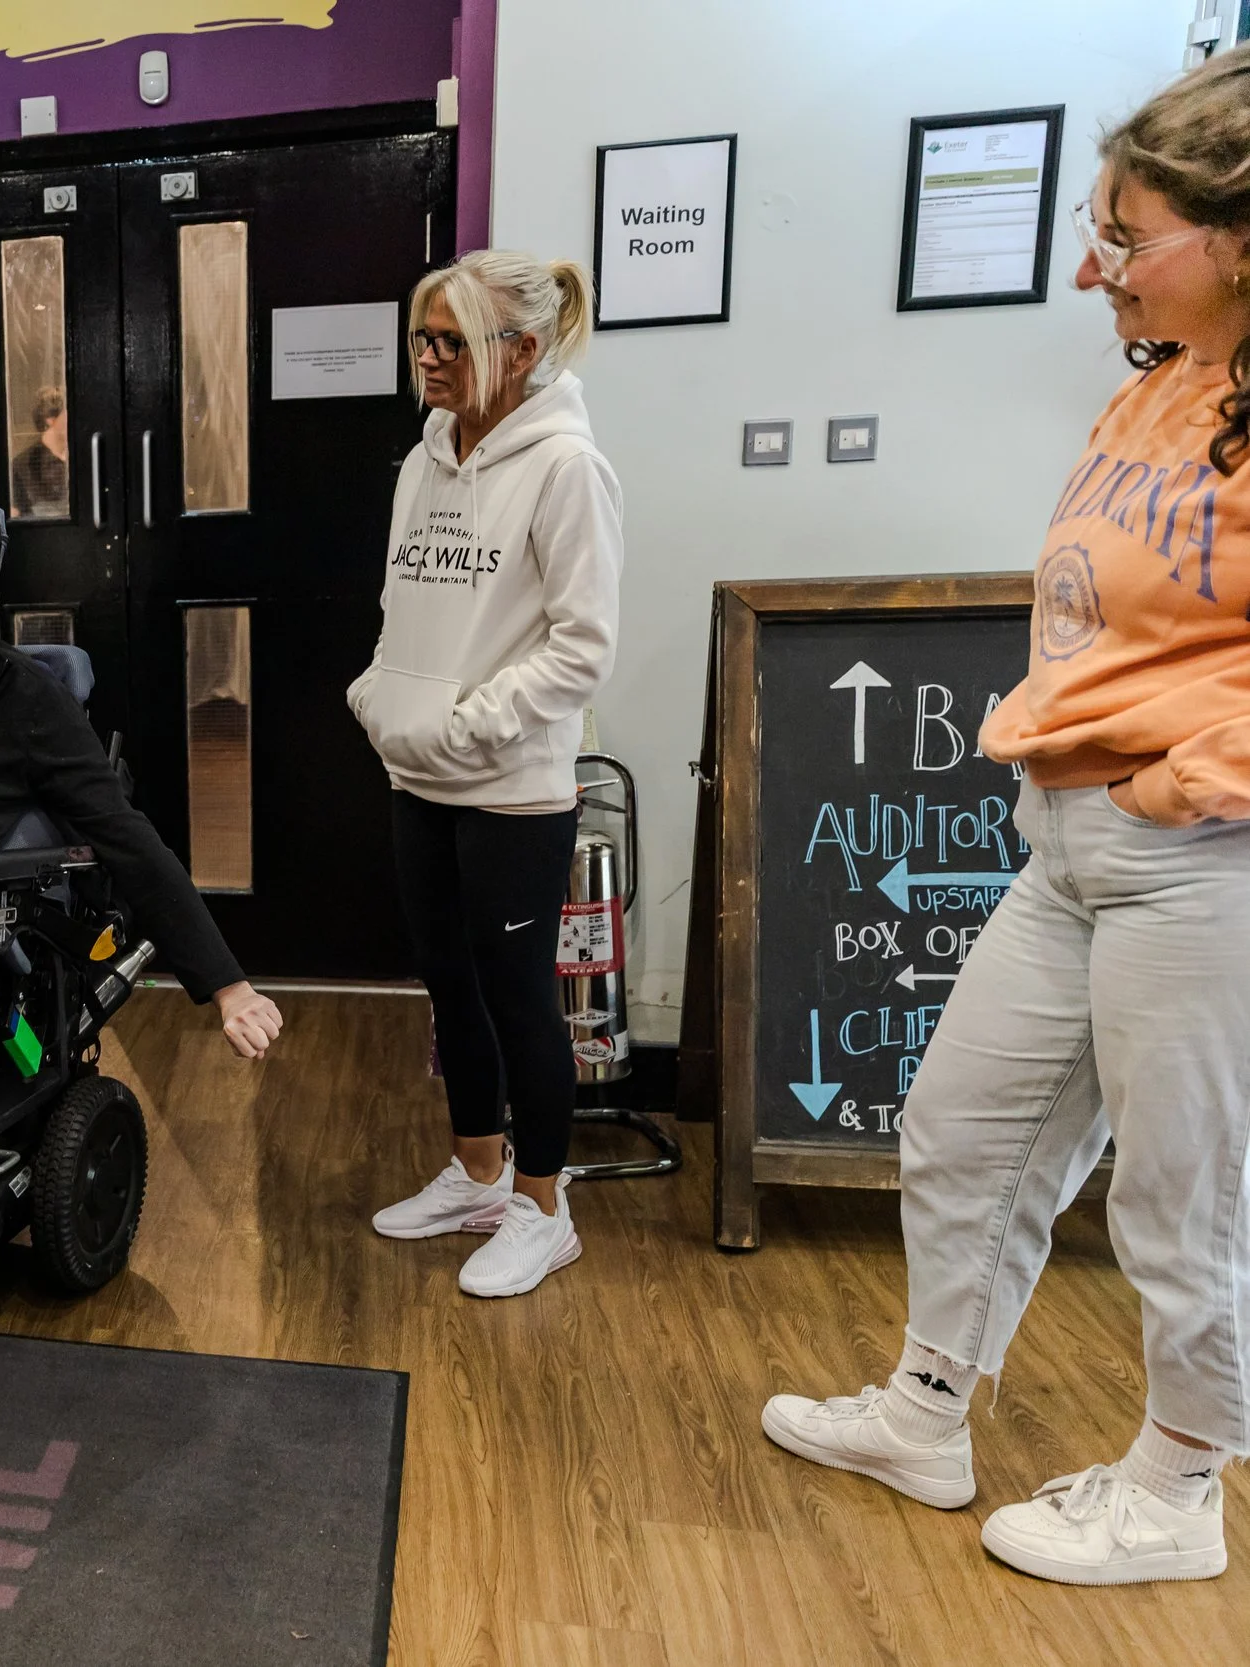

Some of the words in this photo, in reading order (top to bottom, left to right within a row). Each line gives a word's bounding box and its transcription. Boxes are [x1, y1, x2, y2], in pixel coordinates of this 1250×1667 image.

[621, 205, 705, 226] Waiting
[629, 239, 694, 256] Room
[391, 543, 432, 569] JACK
[436, 546, 502, 574] WILLS
[439, 576, 469, 585] BRITAIN
[913, 684, 1024, 781] BA
[835, 920, 904, 962] BOX
[925, 923, 982, 964] OF
[839, 1003, 945, 1055] CLIF
[838, 1099, 866, 1131] &
